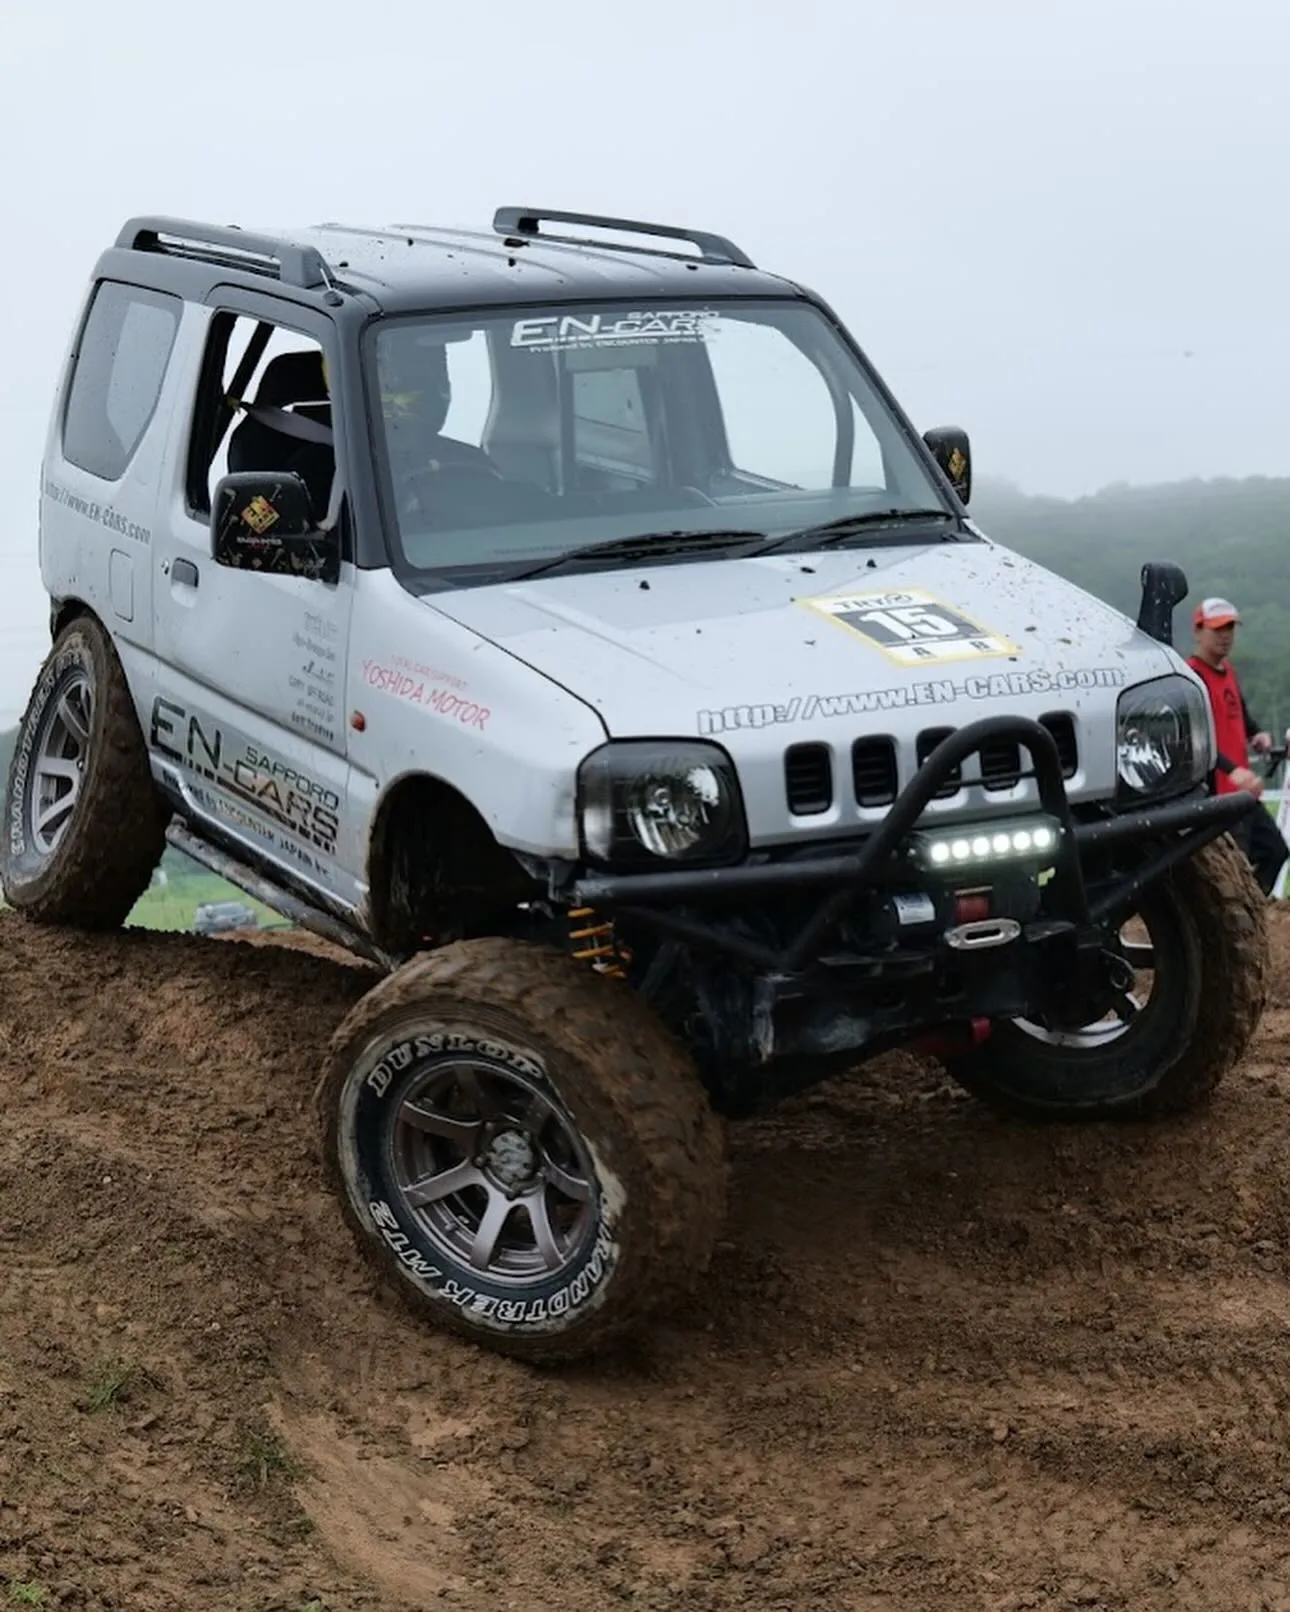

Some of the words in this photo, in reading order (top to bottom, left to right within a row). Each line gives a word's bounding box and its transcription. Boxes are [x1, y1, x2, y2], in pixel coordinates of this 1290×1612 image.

[859, 606, 960, 639] 15
[361, 658, 425, 703] YOSHIDA
[426, 688, 491, 731] MOTOR
[698, 666, 1126, 736] http://www.EN-CARS.com
[151, 695, 340, 843] EN-CARS
[246, 745, 340, 812] SAPPORO
[367, 1033, 545, 1098] DUNLOP
[368, 1199, 443, 1281] MT2
